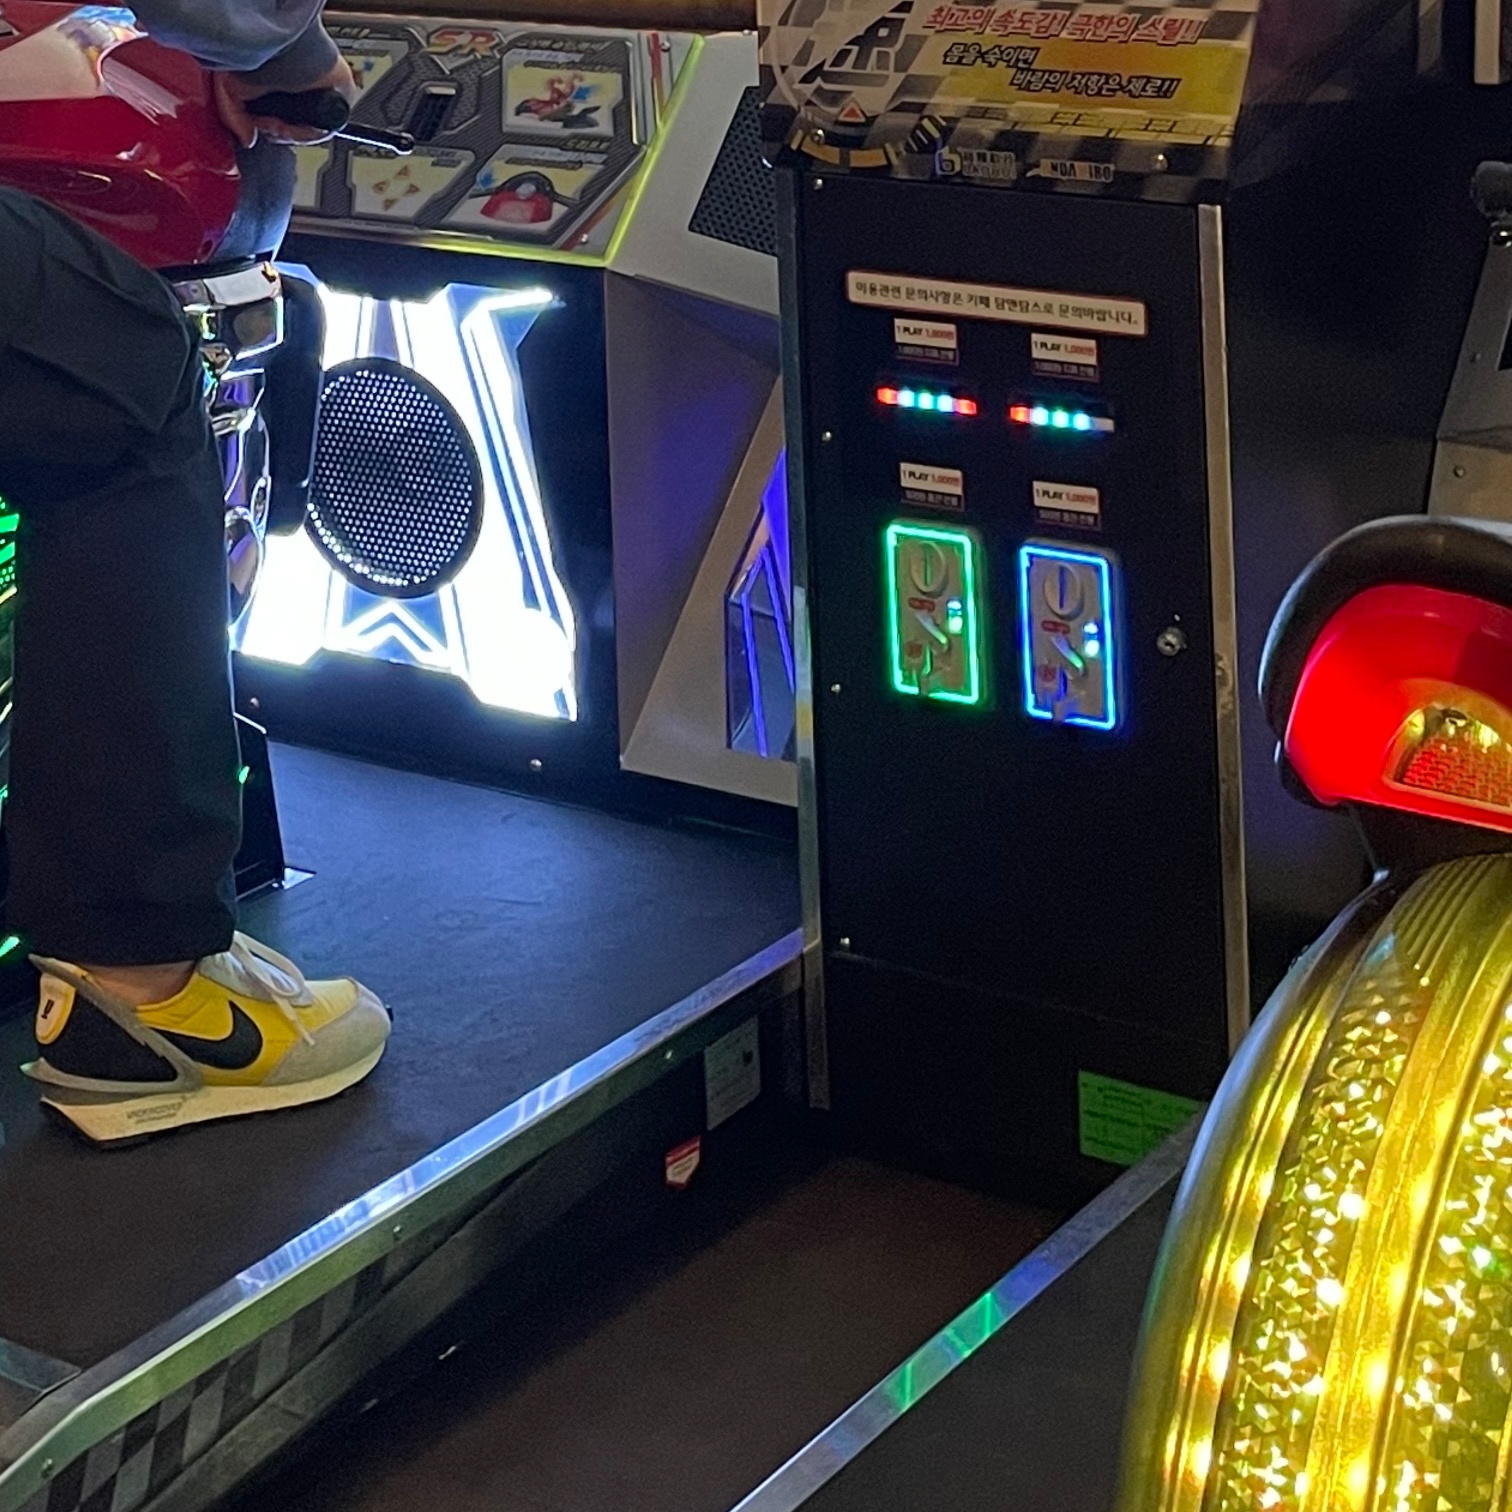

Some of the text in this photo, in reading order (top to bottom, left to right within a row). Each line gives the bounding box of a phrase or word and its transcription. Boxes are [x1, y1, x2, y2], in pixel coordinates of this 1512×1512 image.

[929, 6, 991, 32] 최고의
[994, 10, 1066, 36] 속도감!
[1068, 12, 1136, 38] 극한의
[1013, 70, 1064, 92] 바람의
[1068, 74, 1121, 96] 저항은
